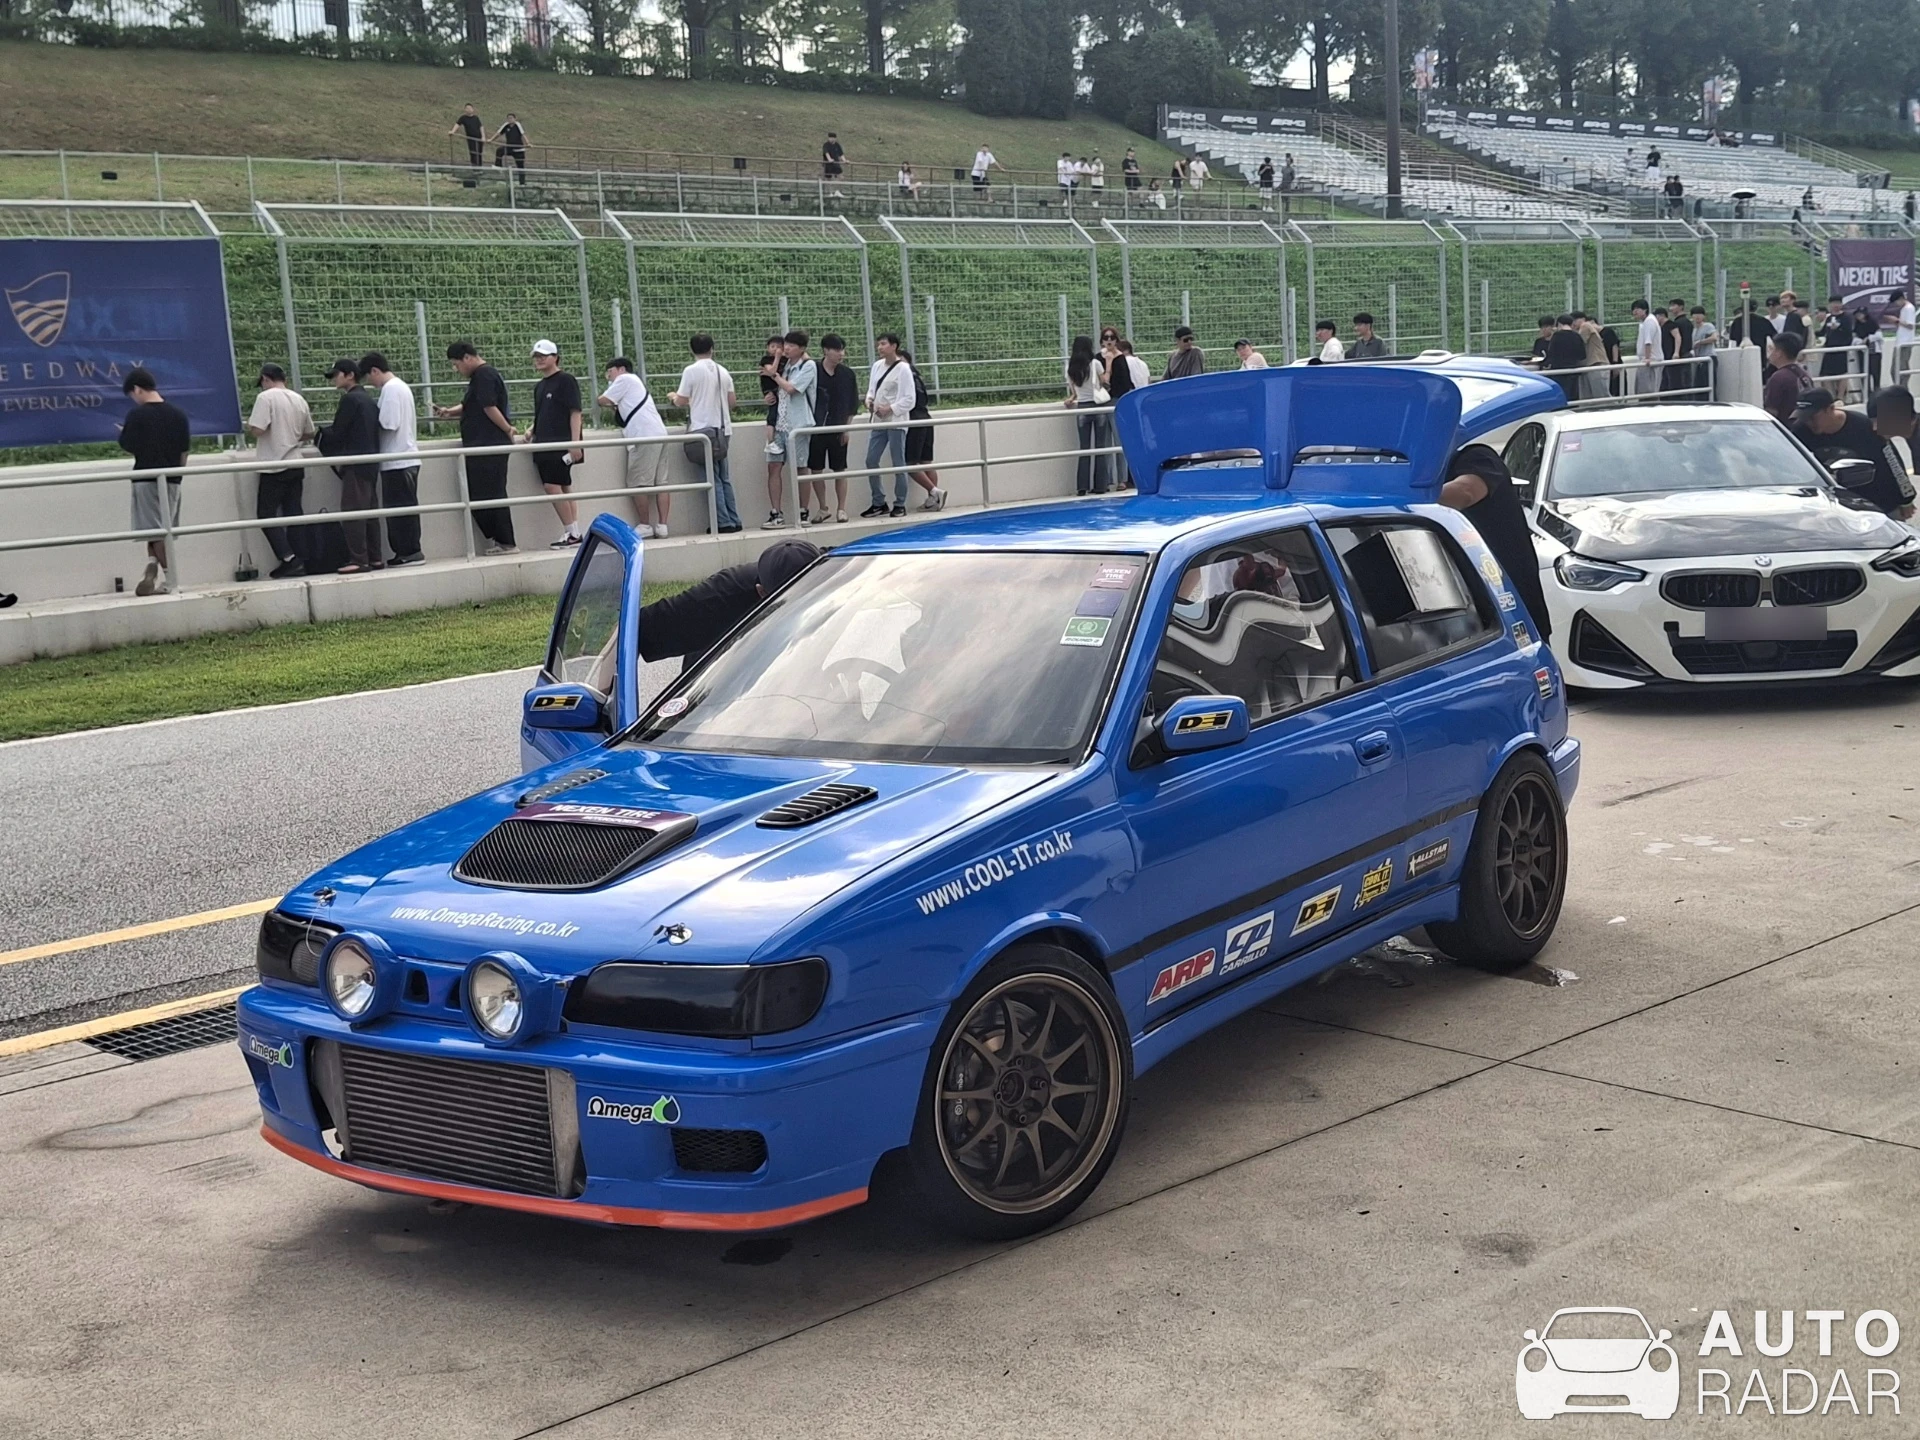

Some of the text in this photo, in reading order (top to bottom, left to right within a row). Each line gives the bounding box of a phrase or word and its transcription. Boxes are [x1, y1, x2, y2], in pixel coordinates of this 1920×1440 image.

[1839, 266, 1879, 287] NEXEN
[4, 393, 103, 412] EVERLAND
[549, 804, 662, 819] NEXEN TIRE
[1415, 843, 1448, 864] ALLSTAR
[916, 830, 1074, 915] www.COOL-IT.co.kr
[390, 906, 581, 938] www.OmegaRacing.co.kr
[1150, 949, 1215, 999] ARP
[1219, 947, 1268, 976] CARRILLO
